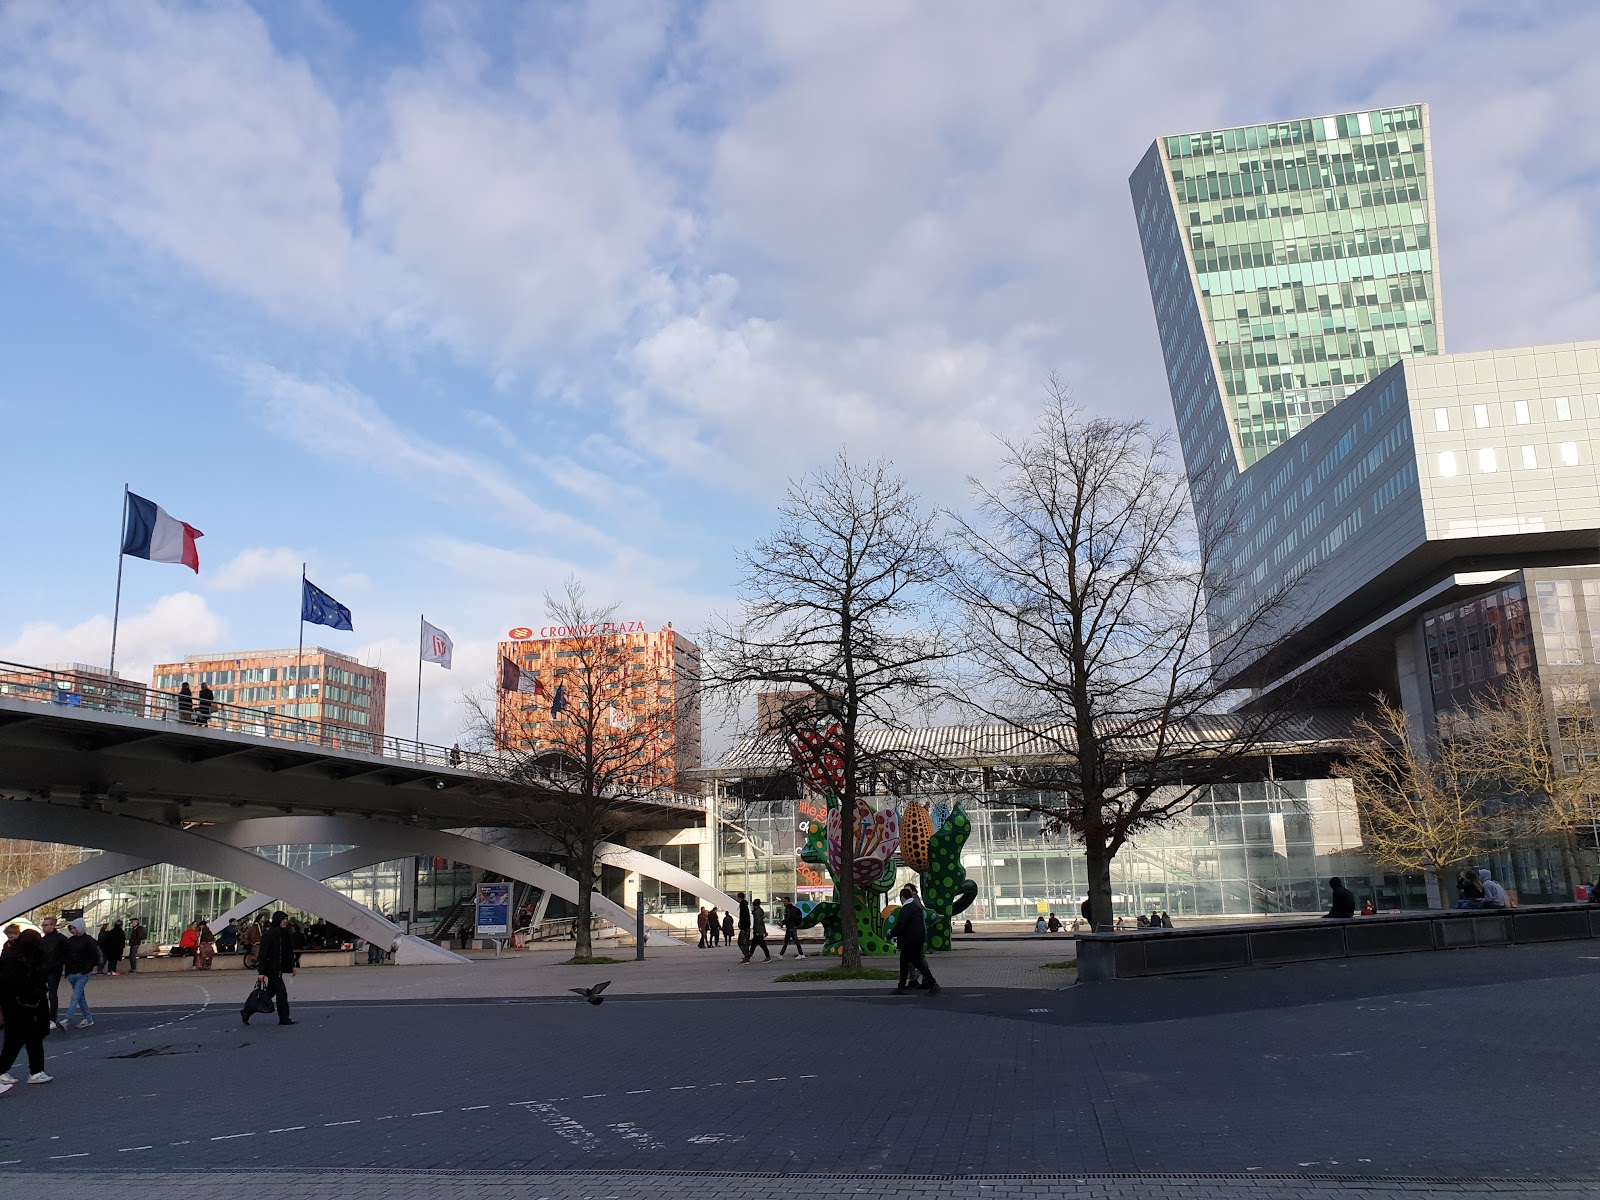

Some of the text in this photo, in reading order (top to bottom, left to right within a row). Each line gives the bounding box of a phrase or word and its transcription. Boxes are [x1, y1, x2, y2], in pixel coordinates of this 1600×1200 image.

[540, 621, 644, 638] CROWNE PLAZA
[796, 862, 822, 885] 2020
